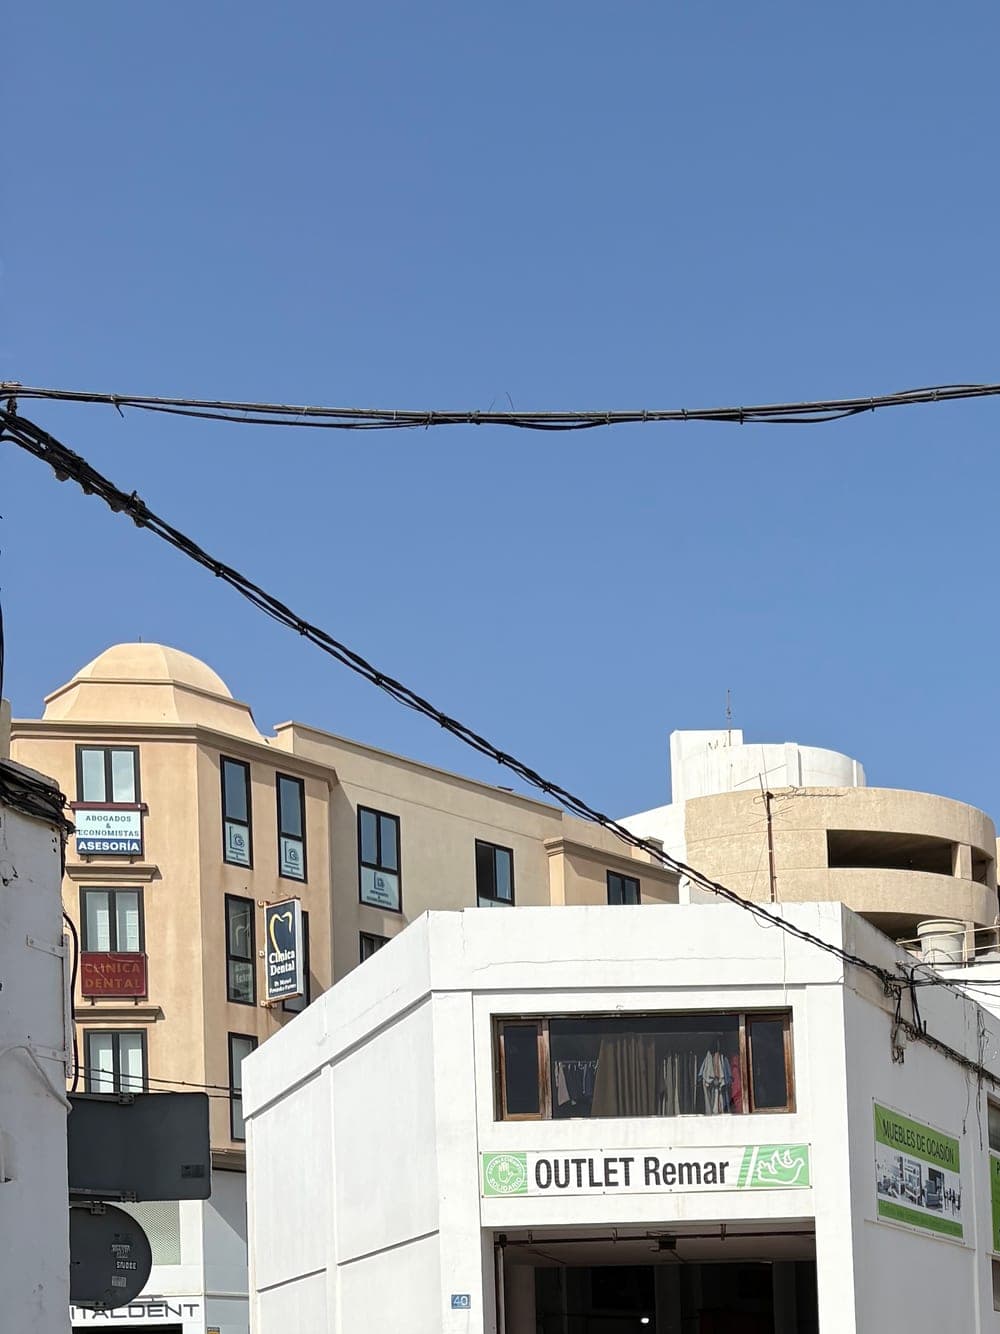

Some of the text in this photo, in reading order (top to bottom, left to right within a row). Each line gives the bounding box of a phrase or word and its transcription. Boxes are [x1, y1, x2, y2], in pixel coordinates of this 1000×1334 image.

[78, 829, 140, 837] ECONOMISTAS
[78, 840, 140, 851] ASESORÍA
[270, 960, 295, 977] Dental
[86, 978, 141, 989] DENTAL
[882, 1119, 916, 1149] MUEBLES
[916, 1133, 926, 1152] DE
[534, 1157, 635, 1189] OUTLET
[643, 1156, 730, 1187] Remar
